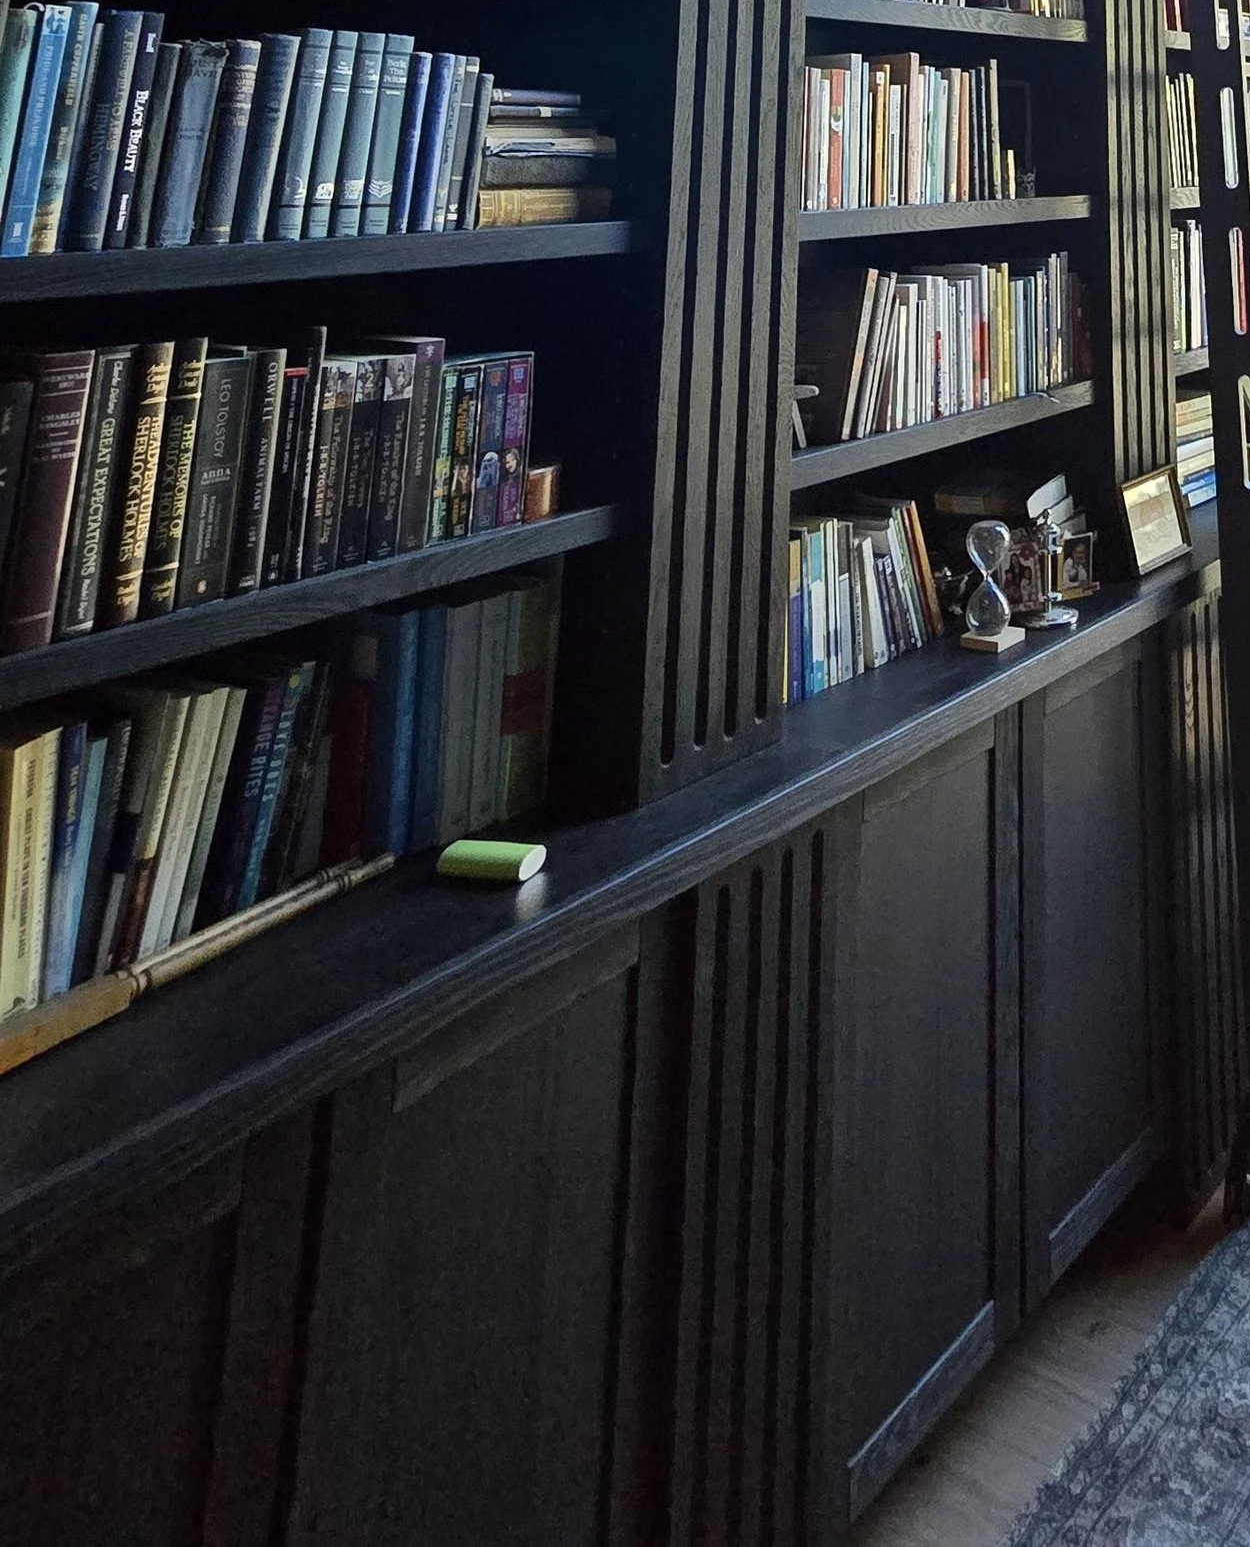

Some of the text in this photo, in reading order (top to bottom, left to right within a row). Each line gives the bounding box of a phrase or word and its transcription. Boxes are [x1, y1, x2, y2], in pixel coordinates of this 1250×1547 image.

[75, 13, 89, 41] DAVID
[64, 43, 84, 105] COPPERFIELD
[113, 39, 133, 98] FAREWELL
[84, 101, 109, 192] HEMINGWAY
[124, 89, 150, 173] BLACK BEAUTY
[261, 361, 278, 423] ORWELL
[366, 372, 375, 388] 2
[97, 417, 117, 464] GREAT
[213, 378, 233, 459] LEO TOLSTOY
[119, 416, 149, 563] SHERLOCK HOLMES
[133, 413, 164, 559] THE ADVENTURES OF
[154, 414, 184, 551] SHERLOCK HOLMES
[169, 420, 196, 539] THE MEMOIRS OF
[256, 436, 269, 480] ANIMAL
[81, 467, 113, 576] EXPECTATIONS
[253, 482, 263, 511] FARM
[244, 757, 268, 799] RITES
[262, 711, 291, 803] LOVE DOES
